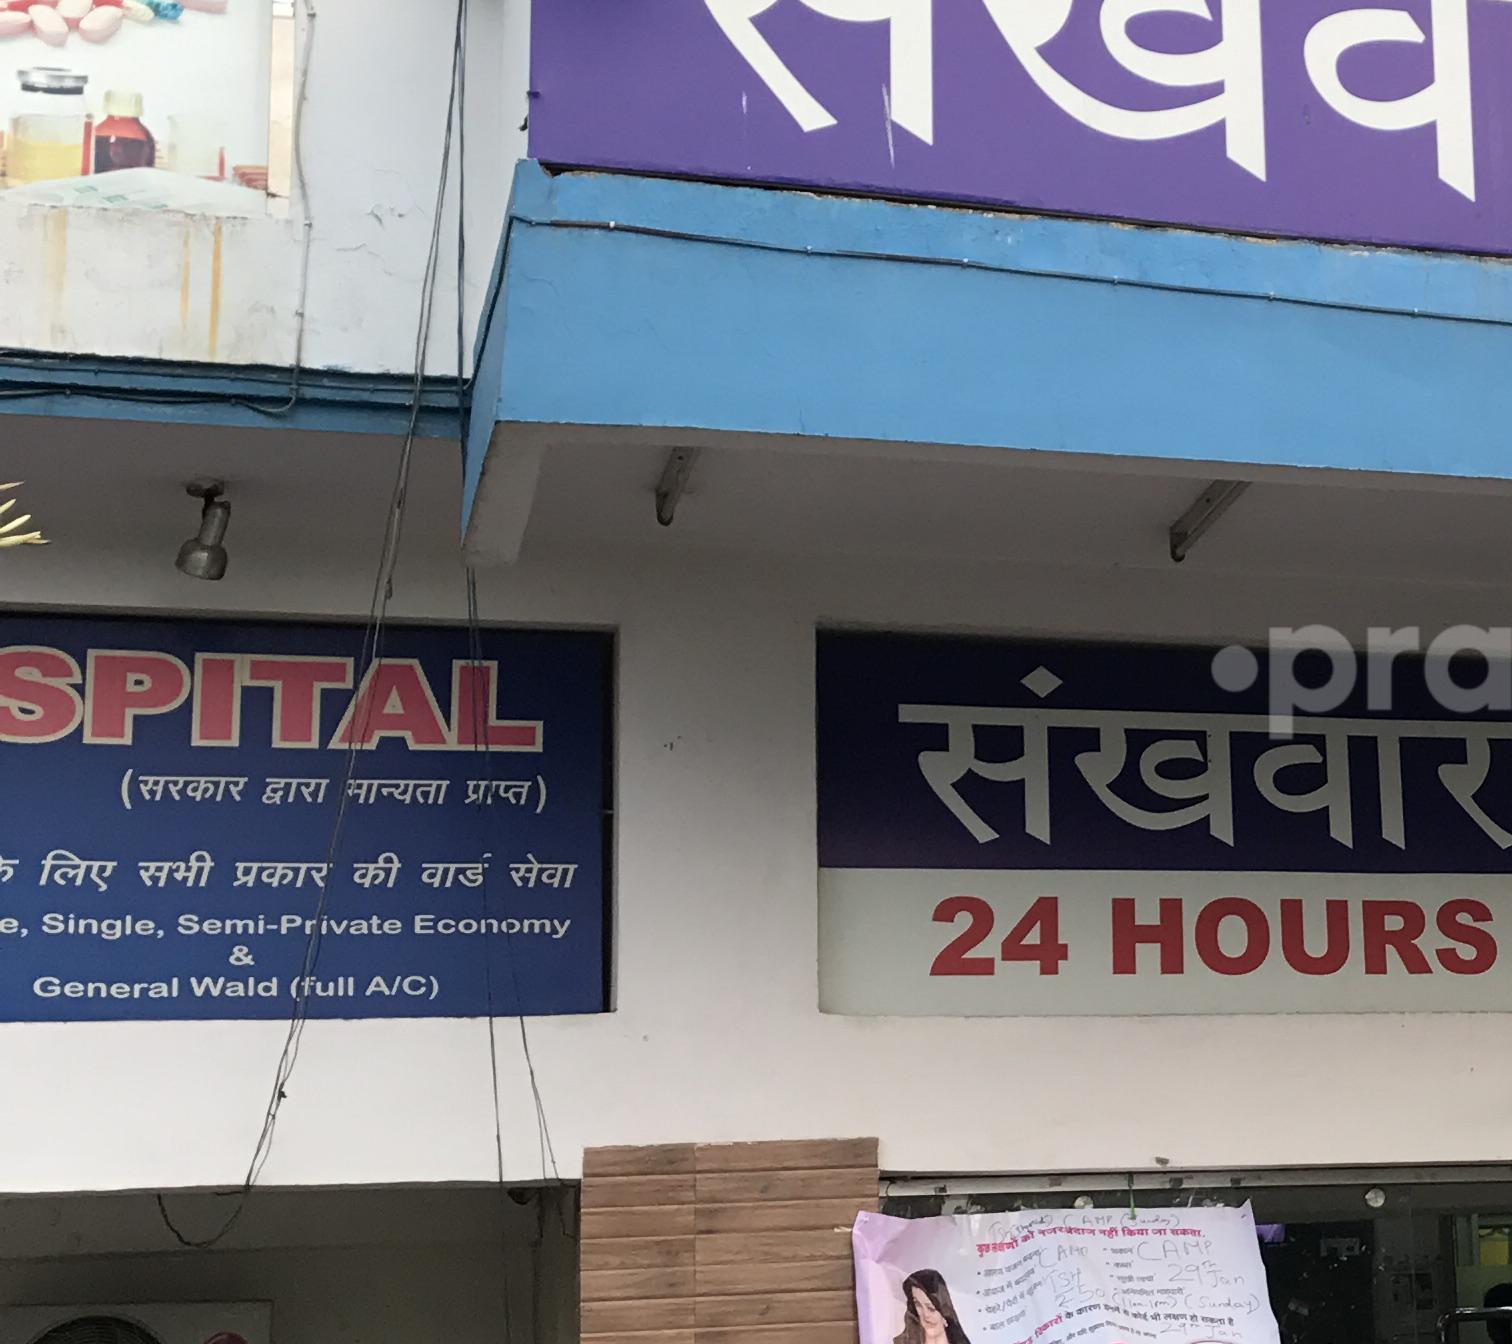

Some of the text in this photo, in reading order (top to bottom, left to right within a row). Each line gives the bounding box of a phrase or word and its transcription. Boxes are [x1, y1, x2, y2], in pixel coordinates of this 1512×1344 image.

[0, 644, 543, 752] SPITAL
[121, 768, 547, 814] (सरकार द्वारा मान्यता प्राप्त)
[39, 849, 117, 892] लिए
[138, 850, 214, 887] सभी
[233, 862, 333, 888] प्रकार
[353, 852, 402, 888] की
[509, 852, 578, 888] सेवा
[41, 912, 164, 940] Single,
[177, 912, 402, 935] Semi-Private
[414, 913, 571, 939] Economy
[929, 896, 1068, 977] 24
[1111, 896, 1499, 977] HOURS
[228, 943, 255, 966] &
[33, 976, 179, 998] General
[365, 975, 440, 999] A/C)
